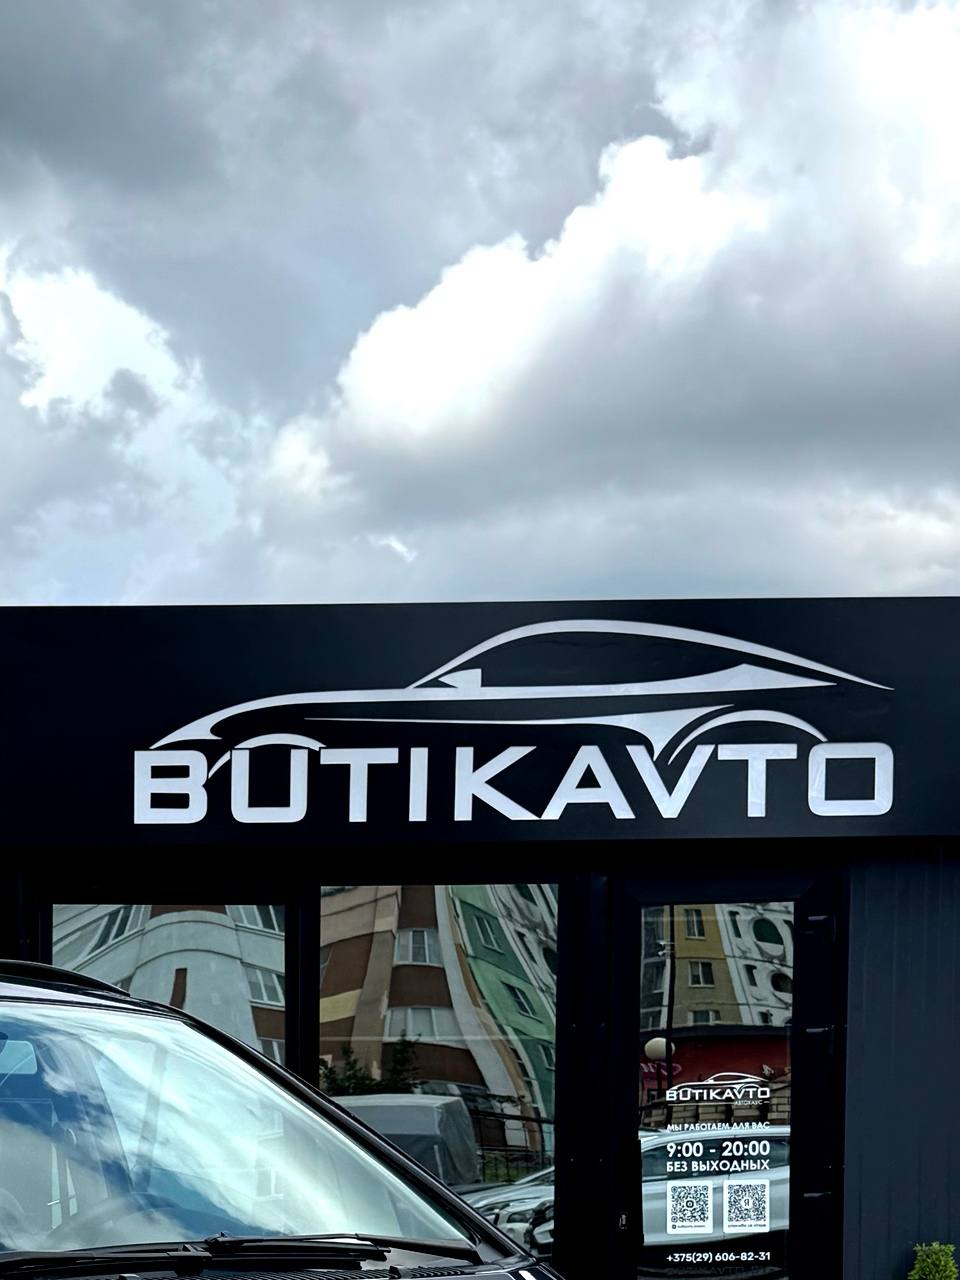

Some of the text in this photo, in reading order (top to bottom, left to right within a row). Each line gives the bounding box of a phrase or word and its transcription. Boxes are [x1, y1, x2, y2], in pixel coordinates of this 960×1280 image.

[133, 741, 895, 825] BUTIKAVTO
[666, 1087, 771, 1101] BUTIKAVTO
[666, 1121, 771, 1132] МЫ РАБОТАЕМ ДЛЯ ВАС
[666, 1142, 704, 1158] 9:00
[721, 1141, 771, 1156] 20:00
[666, 1159, 770, 1172] БЕЗ ВЫХОДНЫХ
[666, 1251, 771, 1263] +375(29) 606-82-31
